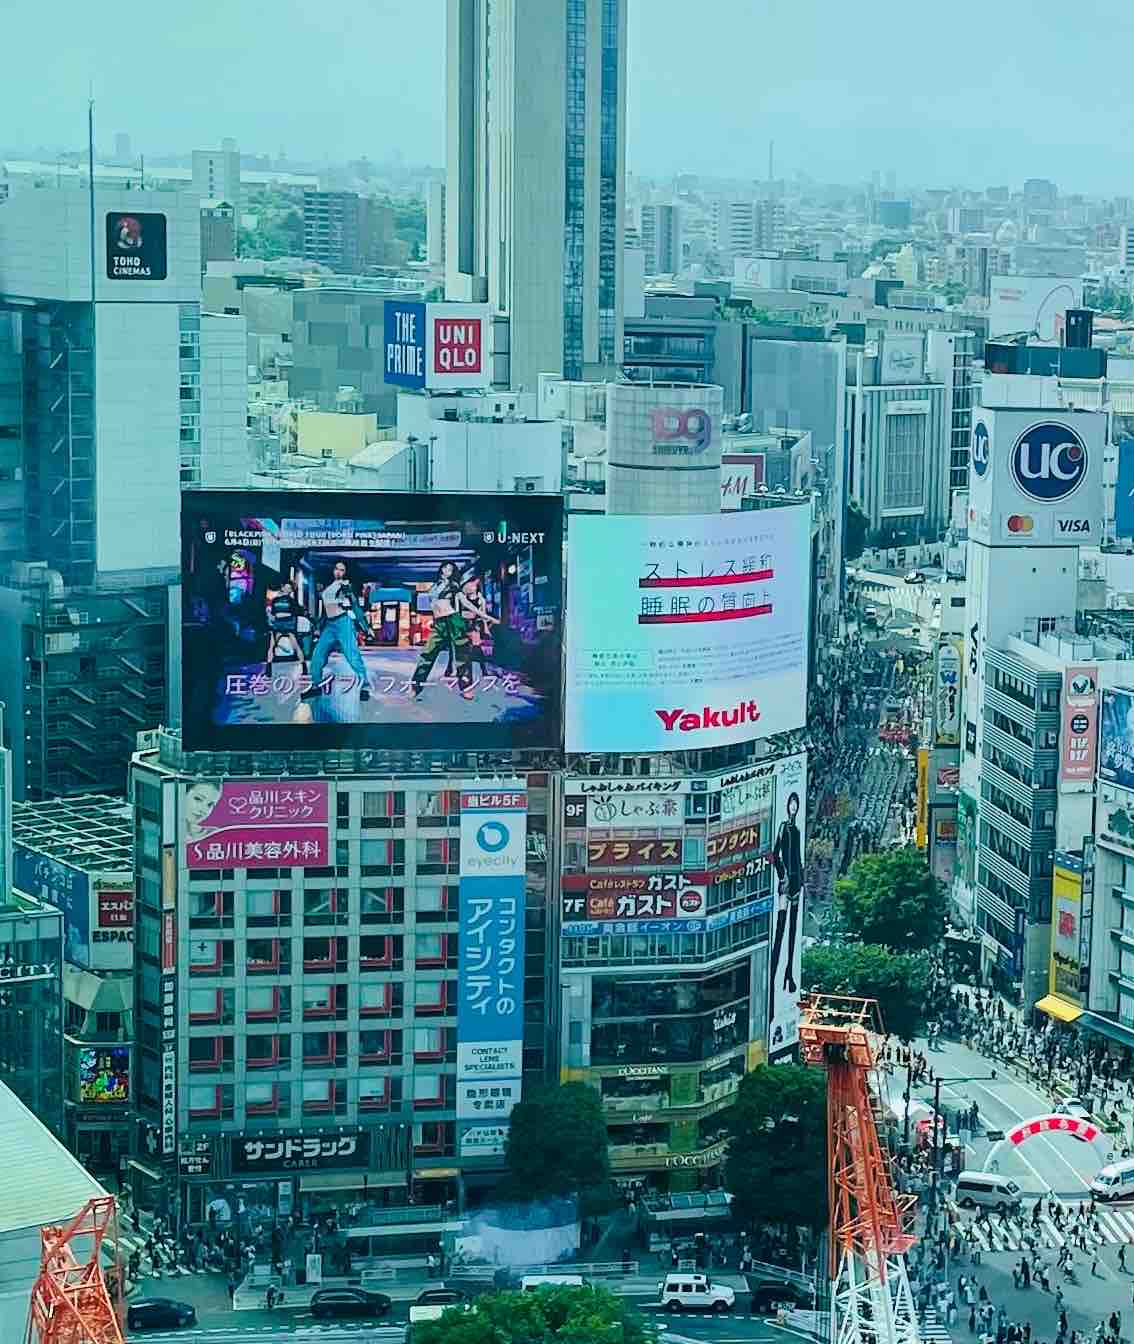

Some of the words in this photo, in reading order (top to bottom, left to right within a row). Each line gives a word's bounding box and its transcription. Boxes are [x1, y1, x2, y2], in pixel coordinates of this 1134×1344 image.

[113, 256, 140, 266] TOHO
[113, 266, 151, 276] CINEMAS
[394, 311, 416, 344] THE
[440, 325, 473, 345] UNI
[387, 343, 423, 377] PRIME
[440, 348, 477, 370] QLO
[1058, 519, 1090, 532] VISA
[656, 700, 761, 731] Yakult
[248, 790, 321, 805] 品川スキン
[248, 806, 313, 819] クリニック
[566, 804, 584, 818] 9F
[207, 841, 320, 861] 品川美容外科
[563, 898, 586, 913] 7F
[616, 893, 673, 916] ガスト
[465, 898, 492, 1015] アイシティ
[496, 897, 516, 1015] コンタクトの
[244, 1136, 358, 1160] サンドラッグ
